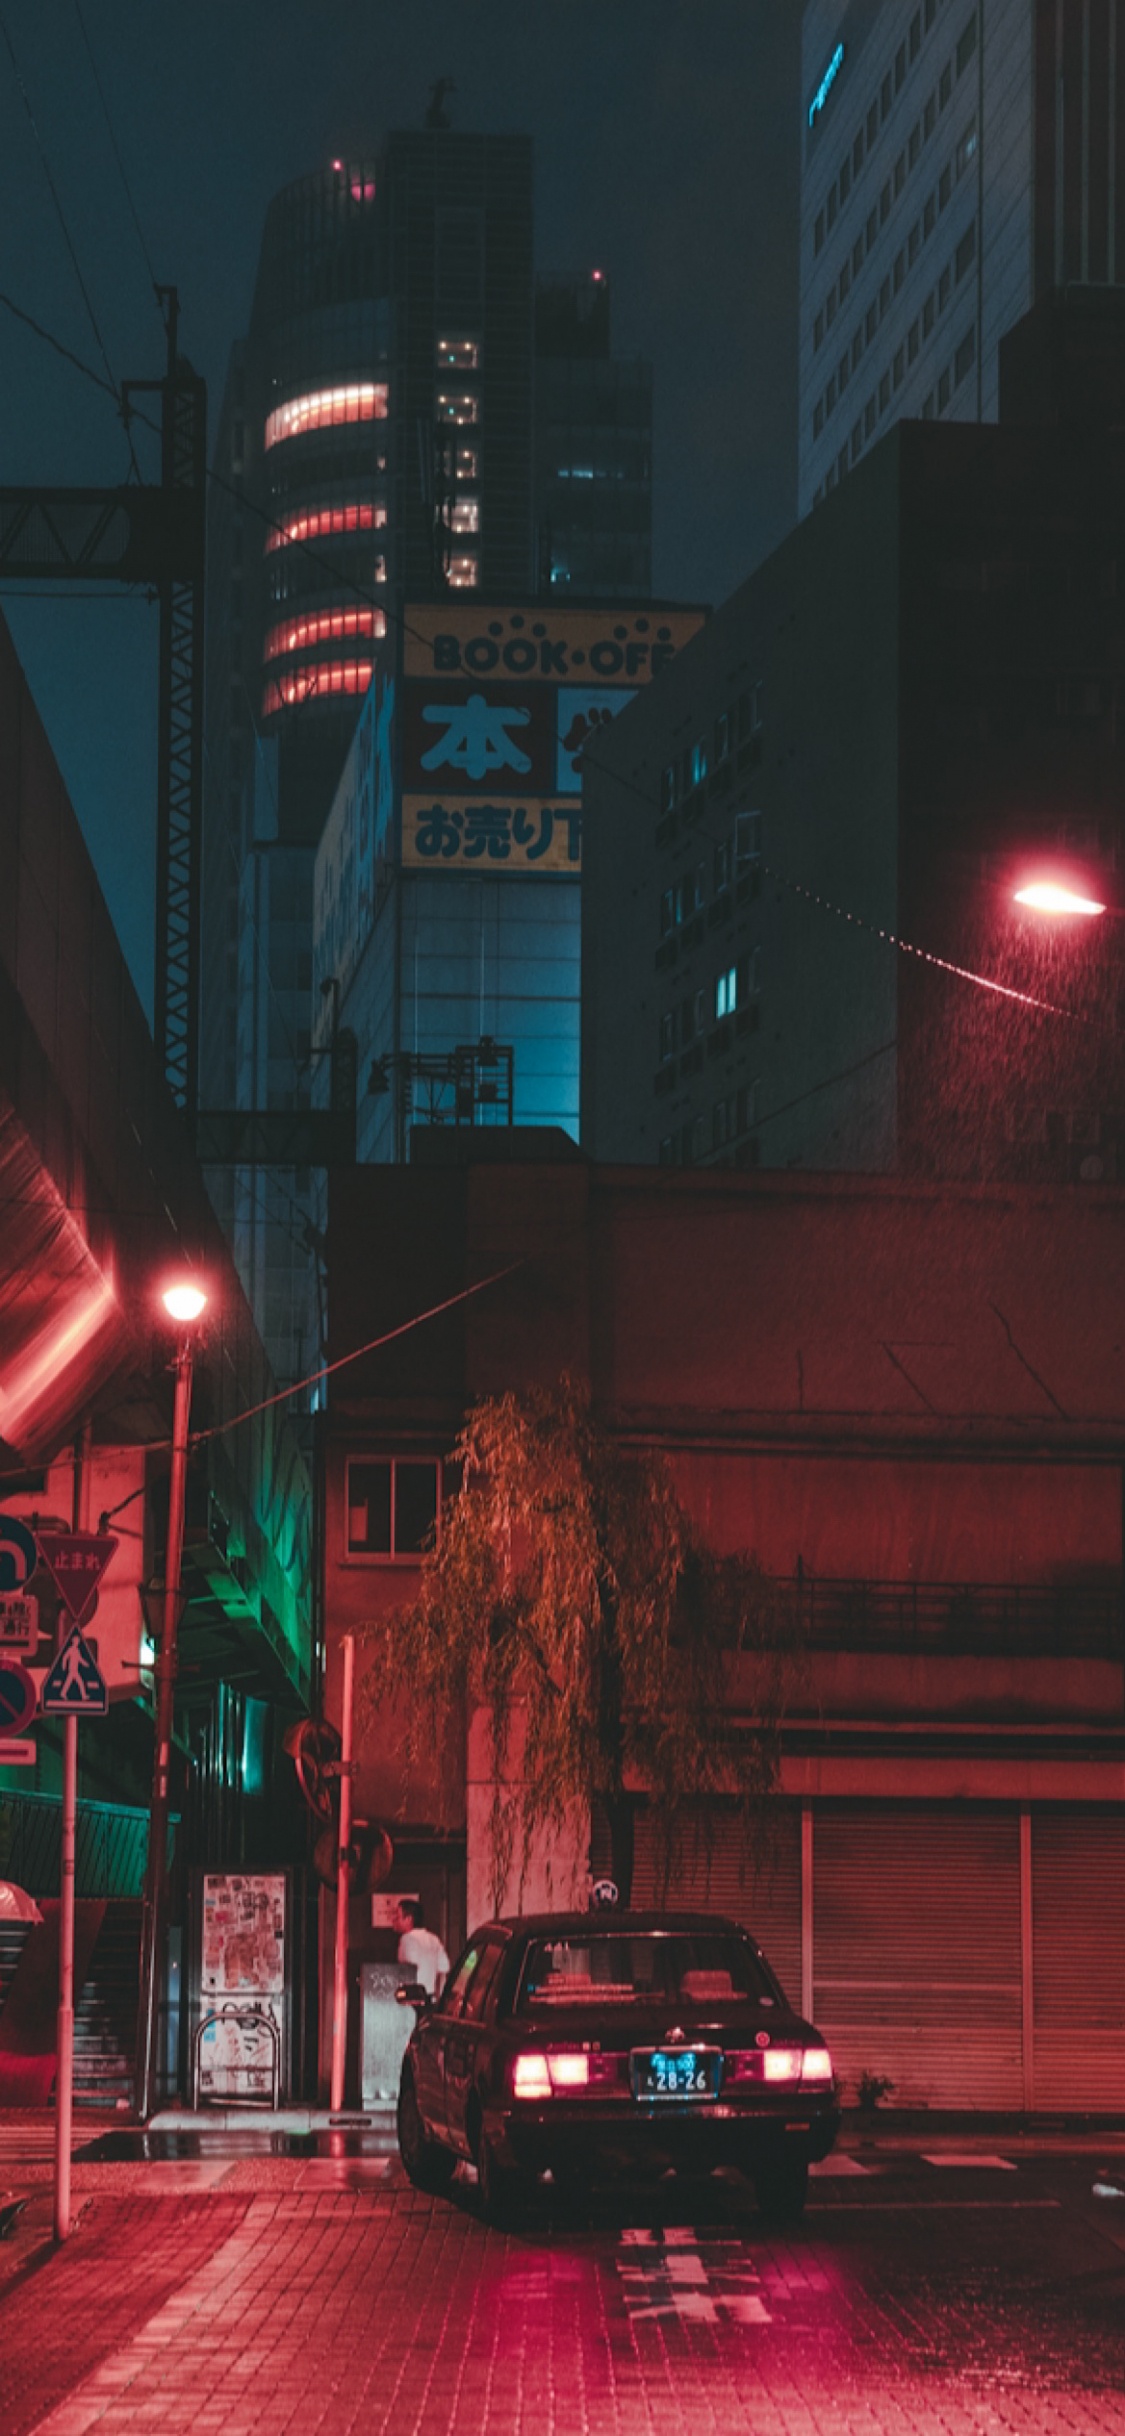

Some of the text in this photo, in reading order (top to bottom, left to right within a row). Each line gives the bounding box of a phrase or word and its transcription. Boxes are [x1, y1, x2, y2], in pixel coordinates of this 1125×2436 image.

[420, 693, 532, 780] 本
[54, 1550, 100, 1570] 止まれ
[656, 2070, 706, 2091] 28-26
